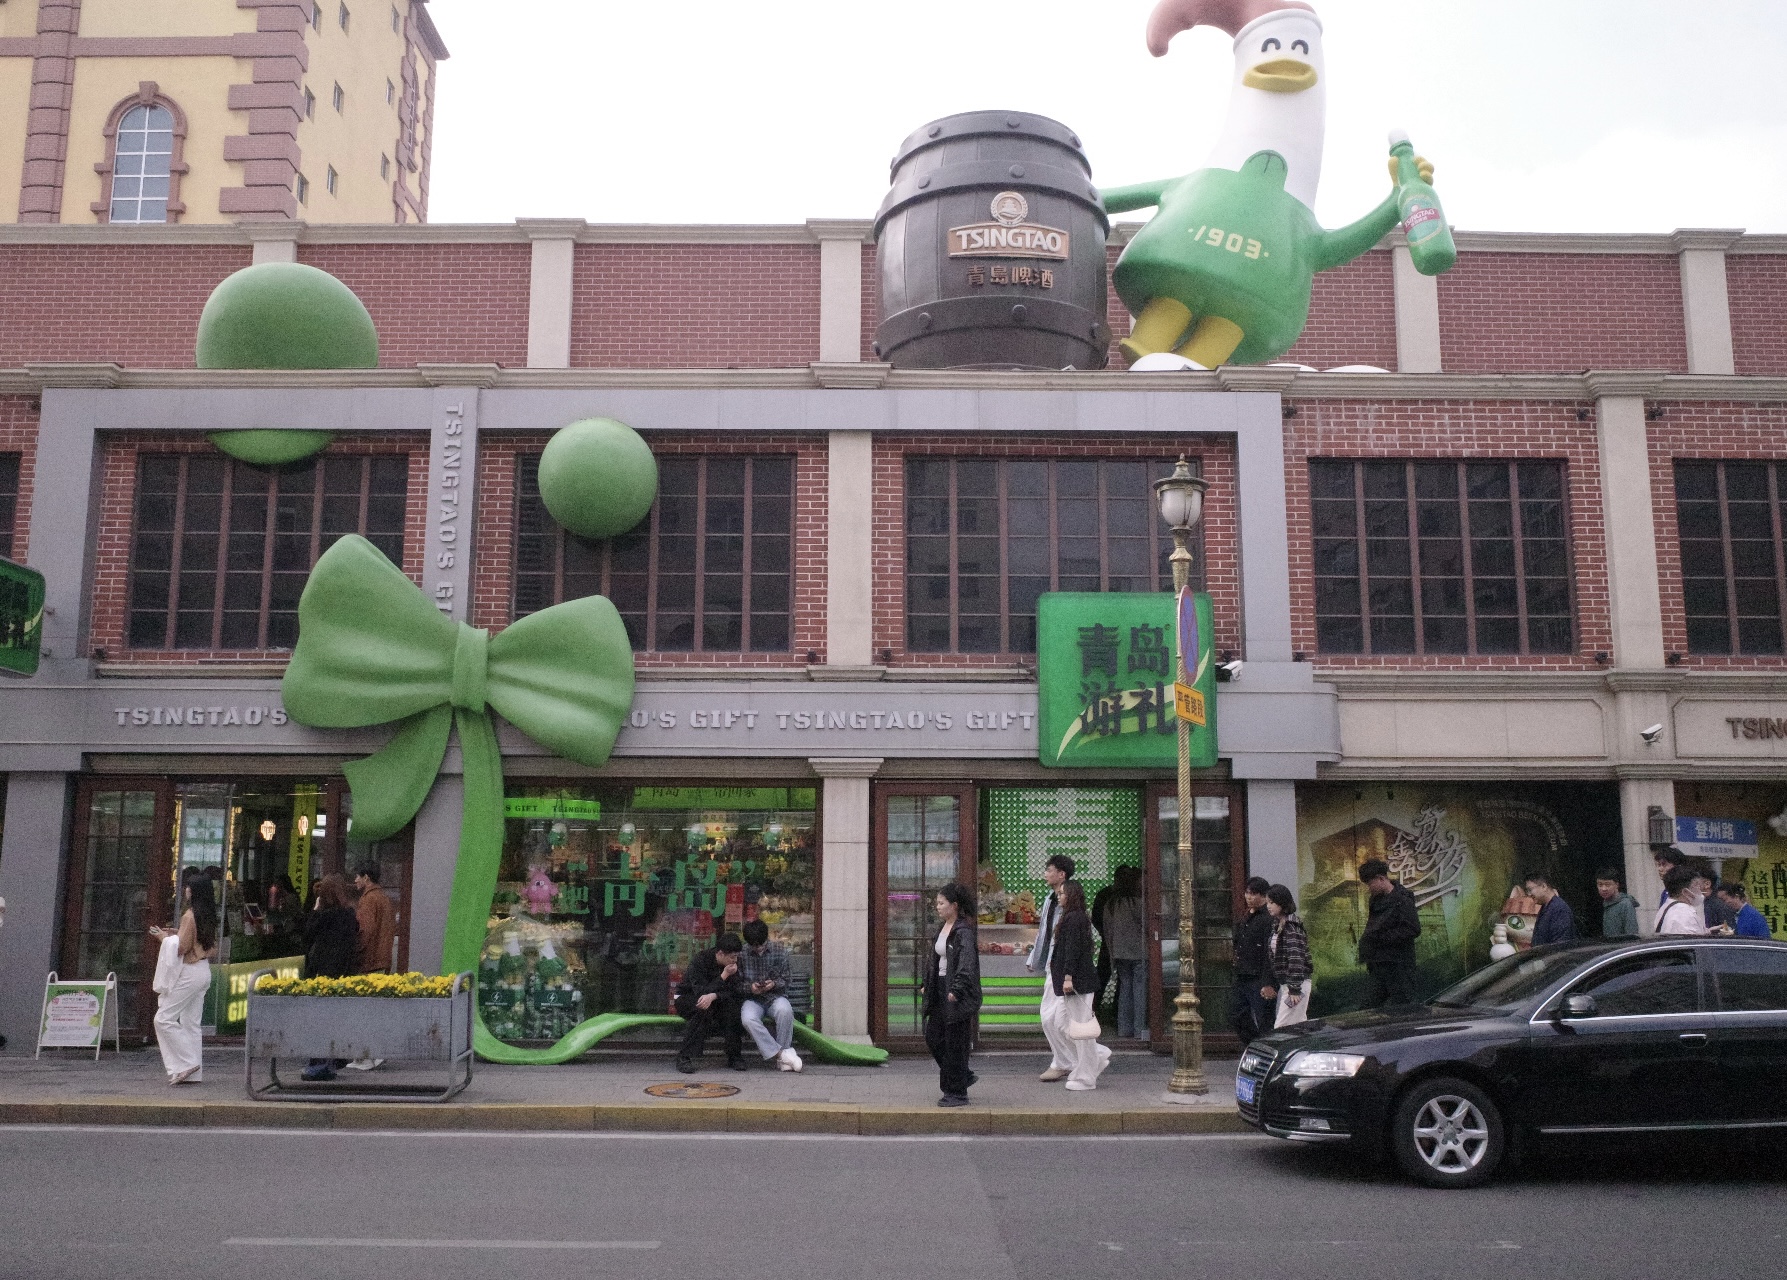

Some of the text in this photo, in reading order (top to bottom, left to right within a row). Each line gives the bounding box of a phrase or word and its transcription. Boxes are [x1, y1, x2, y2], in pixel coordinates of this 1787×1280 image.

[1404, 208, 1436, 228] TSINGTAO
[956, 228, 1062, 252] TSINGTAO
[435, 402, 464, 613] TSINGTAO'S GI
[1077, 623, 1169, 677] 青岛
[114, 706, 288, 726] TSINGTAO'S
[690, 710, 759, 729] GIFT
[776, 710, 953, 730] TSINGTAO'S
[966, 711, 1035, 730] GIFT
[1725, 718, 1787, 740] TSIN
[1695, 820, 1734, 841] 登州路
